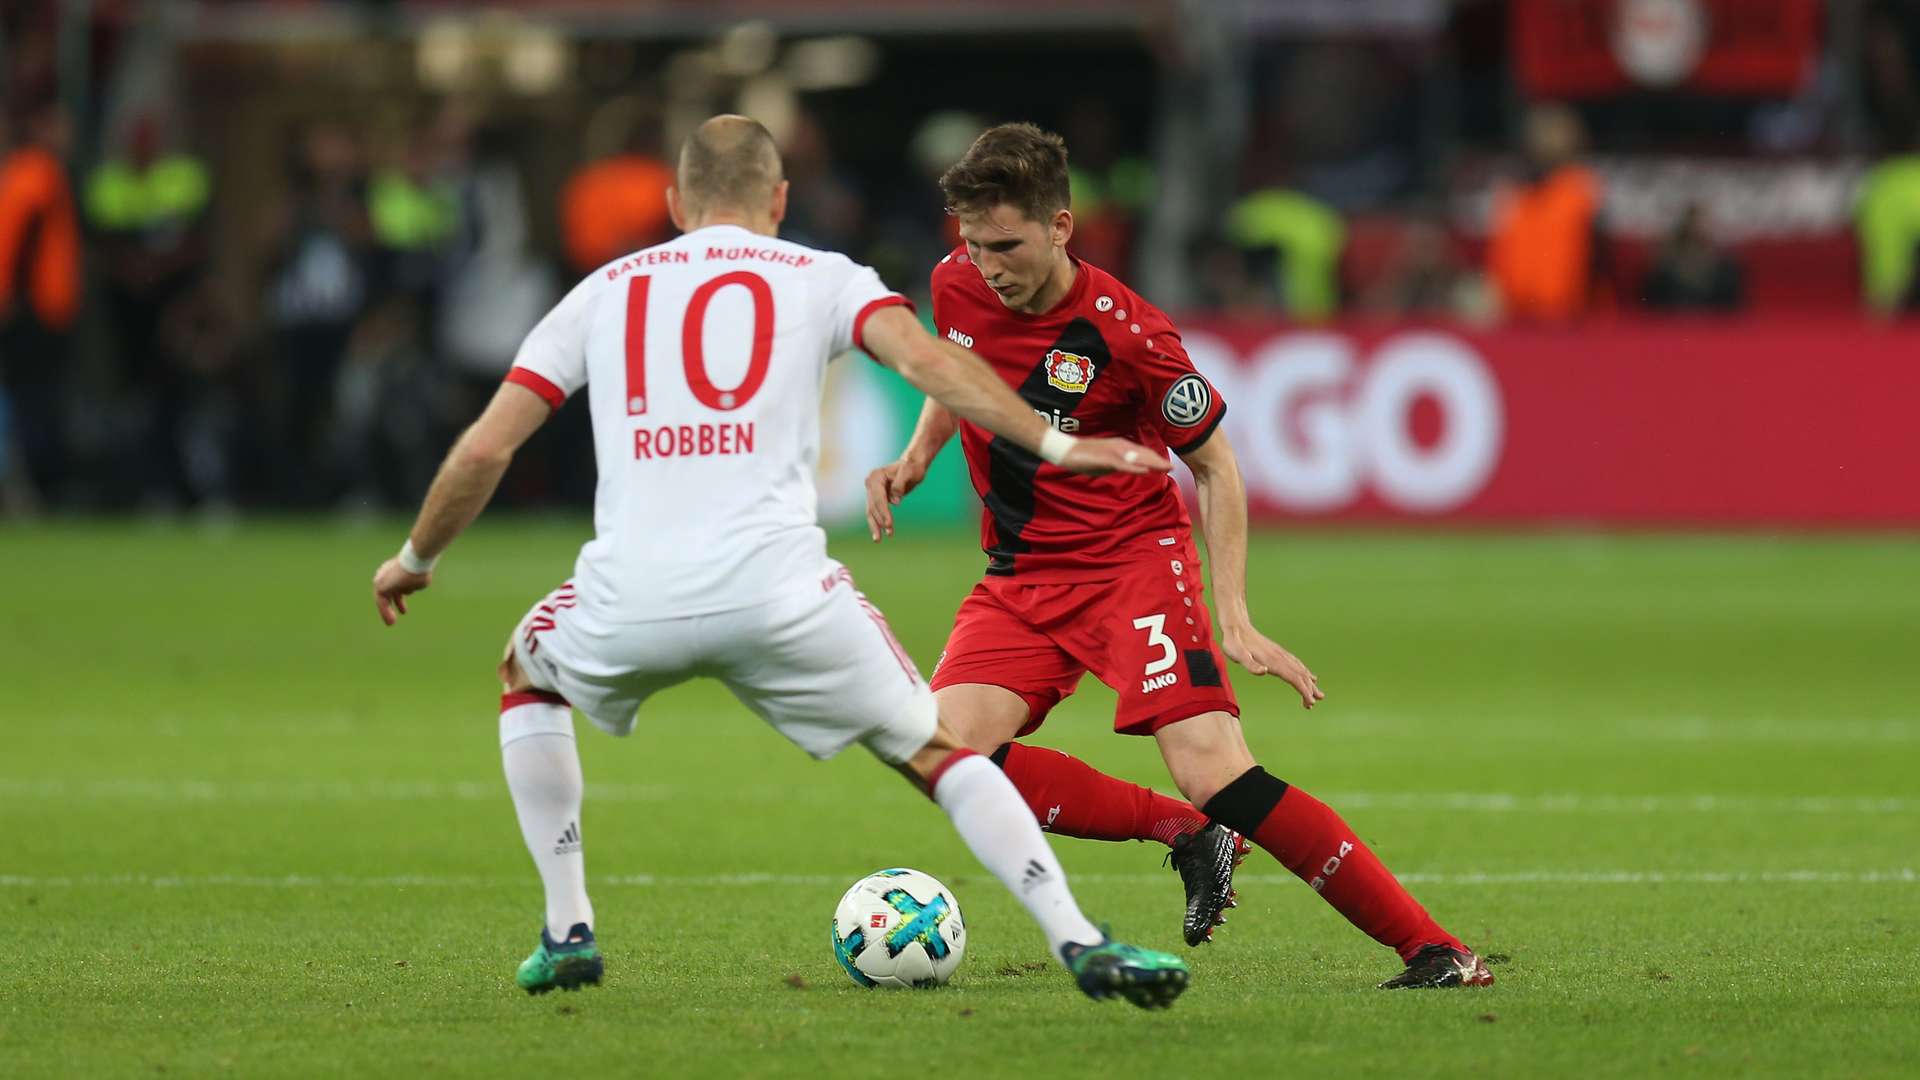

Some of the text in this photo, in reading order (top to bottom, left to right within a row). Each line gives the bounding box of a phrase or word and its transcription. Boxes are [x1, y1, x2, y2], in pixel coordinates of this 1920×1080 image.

[606, 251, 690, 281] BAYERN
[625, 270, 775, 416] 10
[947, 326, 974, 348] JAKO
[1180, 328, 1505, 514] GO
[634, 422, 754, 460] ROBBEN
[1132, 613, 1178, 676] 3
[1142, 672, 1177, 694] JAKO
